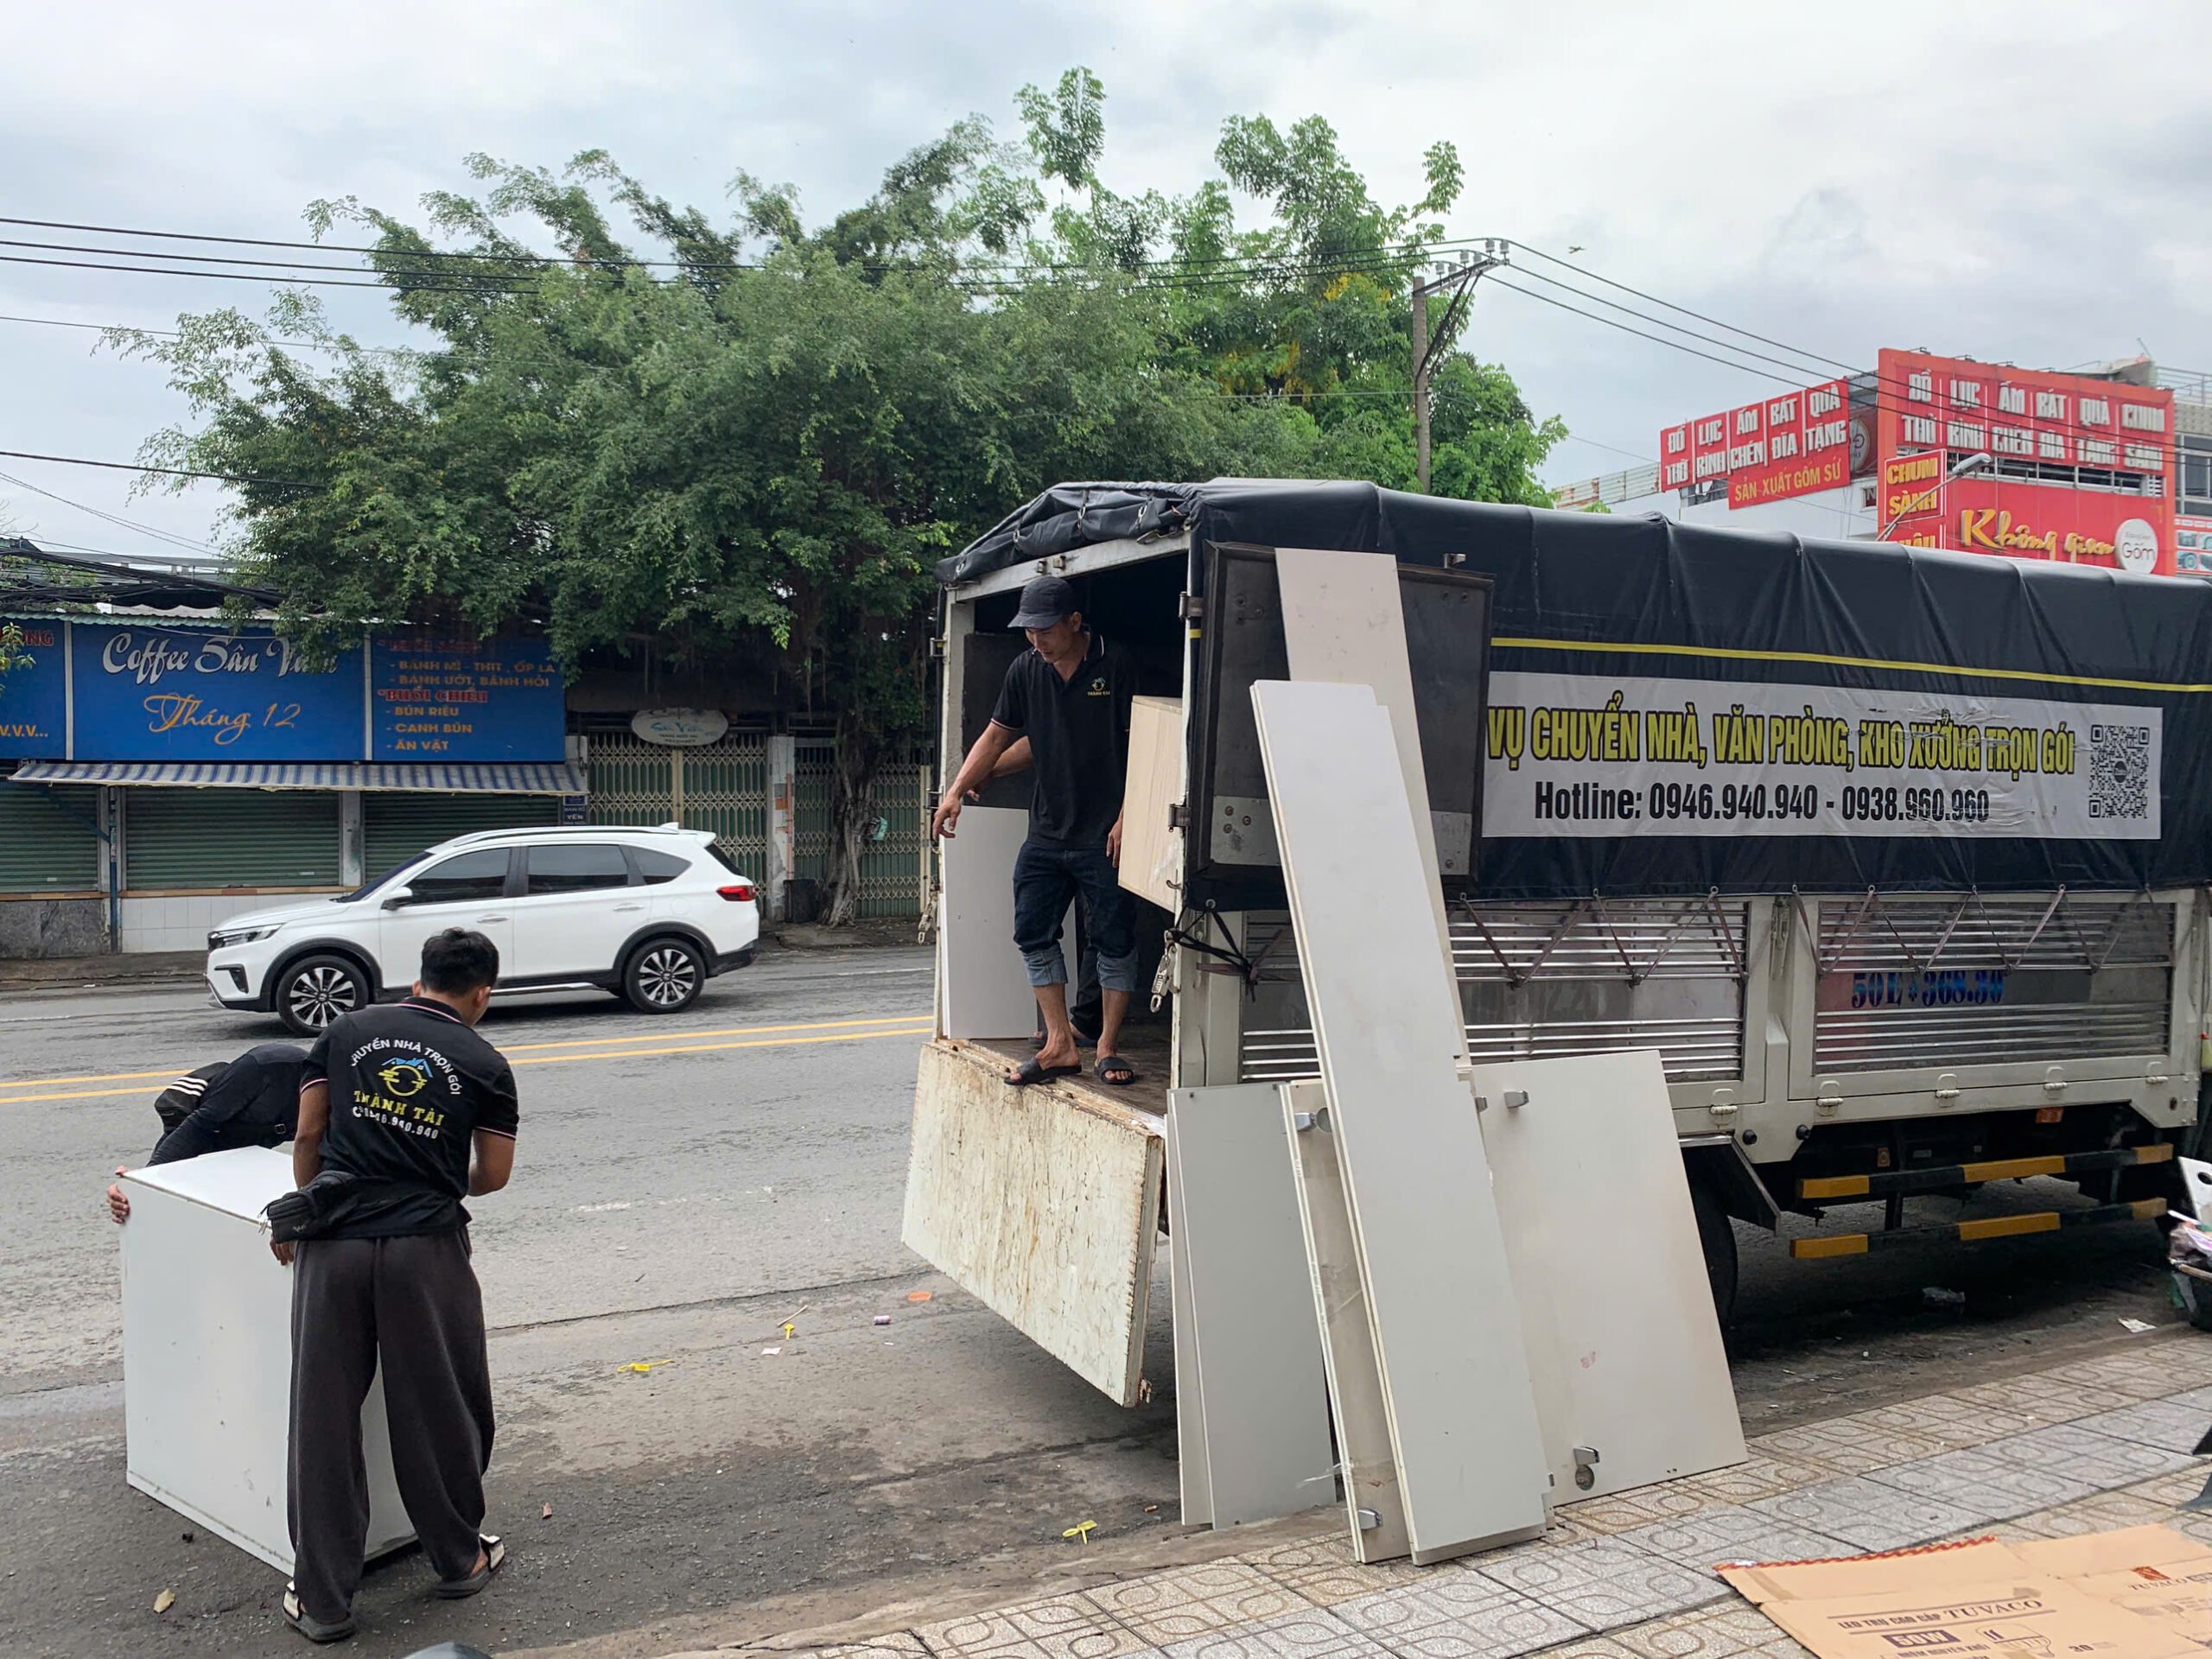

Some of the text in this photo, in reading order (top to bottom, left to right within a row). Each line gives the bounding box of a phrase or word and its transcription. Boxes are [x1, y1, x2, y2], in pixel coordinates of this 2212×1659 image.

[1909, 368, 1932, 403] ĐỒ
[1949, 379, 1981, 410] LỤC
[2036, 388, 2067, 420] BÁT
[2079, 395, 2111, 427] QUÀ
[2121, 403, 2165, 433] CHUM
[1668, 384, 1840, 454] ĐỒ LỤC ẤM BÁT QUÀ
[1666, 420, 1847, 485] THỜ BÌNH CHÉN ĐĨA TẶNG
[1901, 412, 1937, 445] THỜ
[1947, 419, 1985, 450] BÌNH
[1992, 423, 2034, 455] CHÉN
[2038, 429, 2066, 460] ĐĨA
[2075, 434, 2116, 467] TẶNG
[1734, 459, 1841, 502] SẢN XUẤT GỐM SỨ
[1886, 457, 1938, 486] CHUM
[1889, 488, 1938, 516] SÀNH
[1961, 508, 2057, 561] Không
[2121, 542, 2156, 561] Gốm
[103, 632, 190, 685] Coffee
[194, 636, 258, 674] Sân
[539, 664, 556, 673] LA
[524, 674, 549, 688] HỎI
[143, 692, 301, 746] Tháng 12
[395, 703, 425, 716] BÚN
[429, 704, 460, 716] RIÊU
[395, 723, 438, 734] CANH
[442, 721, 472, 734] BÚN
[1487, 690, 2076, 782] VỤ CHUYỂN NHÀ, VĂN PHÒNG, KHO XƯỞNG TRỌN GÓI
[395, 738, 416, 750] ĂN
[421, 739, 449, 753] VẶT
[1535, 780, 1643, 820] Hotline:
[1649, 782, 1818, 821] 0946.940.940
[1842, 785, 1990, 823] 0938.960.960
[393, 1039, 422, 1053] NHÀ
[424, 1047, 454, 1074] TRỌN
[448, 1074, 463, 1096] GÓI
[413, 1107, 445, 1127] TÀI
[2128, 1578, 2188, 1591] TUVACO
[1943, 1599, 2044, 1619] TUVACO
[1891, 1630, 1949, 1648] 50W
